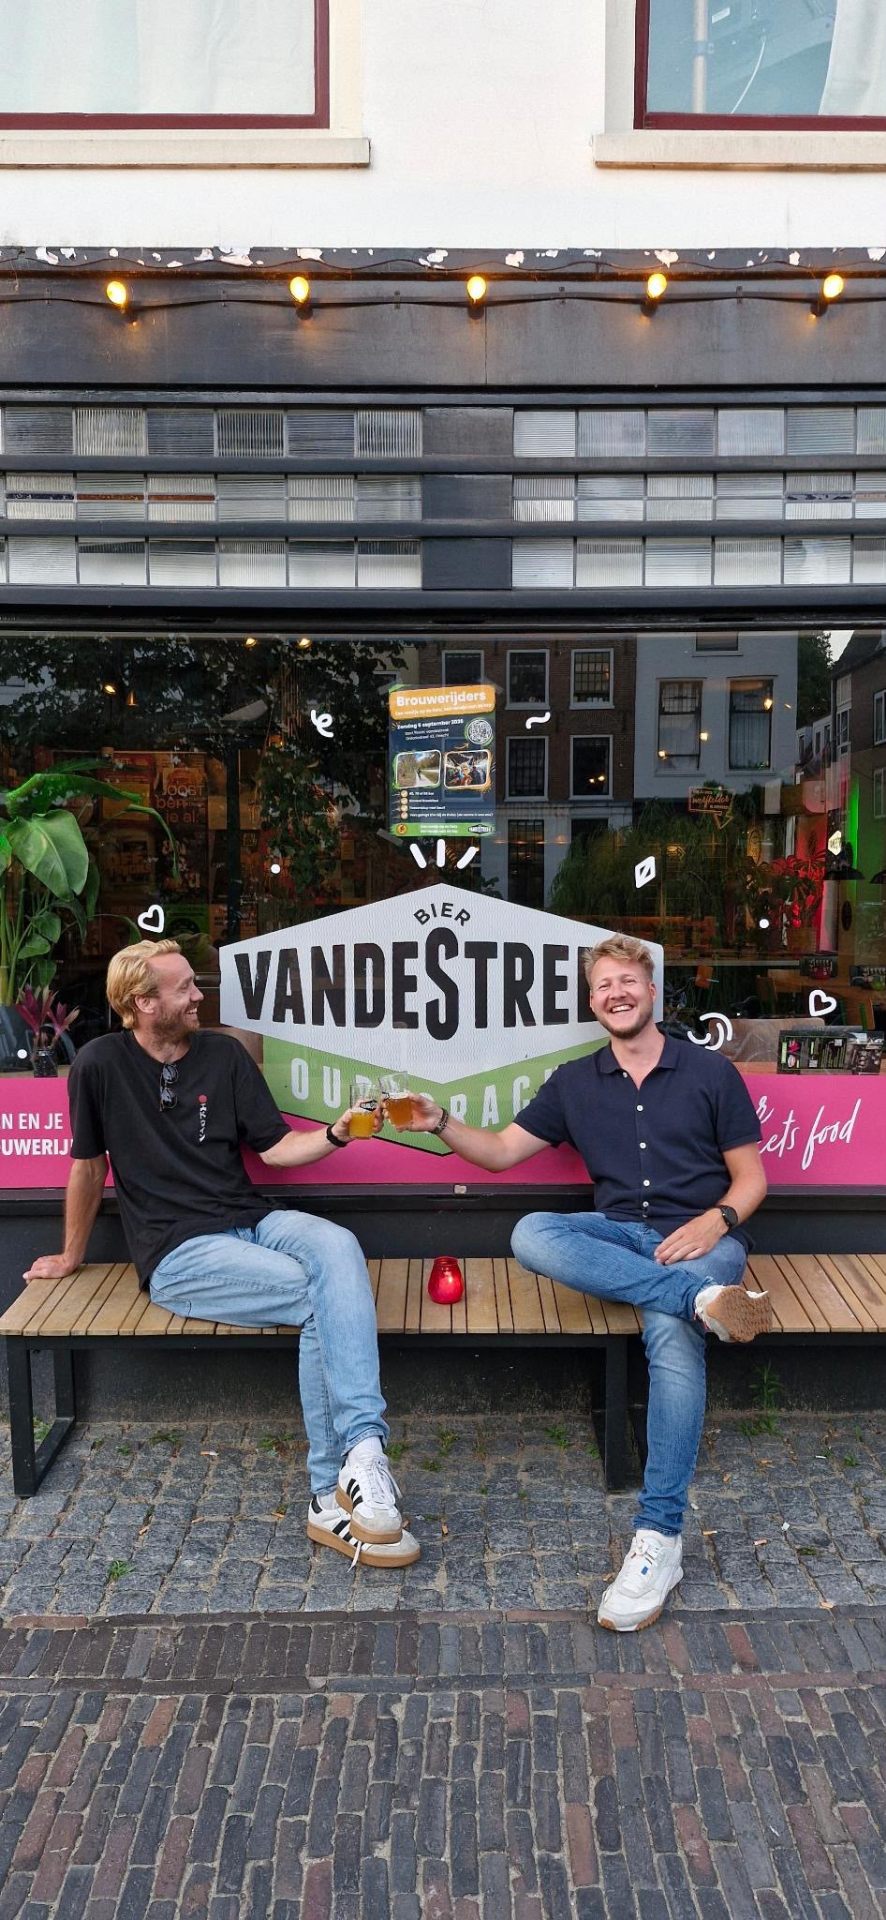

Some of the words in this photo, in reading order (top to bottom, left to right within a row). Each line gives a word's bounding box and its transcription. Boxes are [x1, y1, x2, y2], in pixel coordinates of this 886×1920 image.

[396, 691, 487, 707] Brouwerijders
[413, 902, 471, 926] BIER
[234, 927, 599, 1041] VANDESTRE
[19, 1113, 40, 1130] EN
[44, 1113, 64, 1130] JE
[801, 1098, 862, 1171] food
